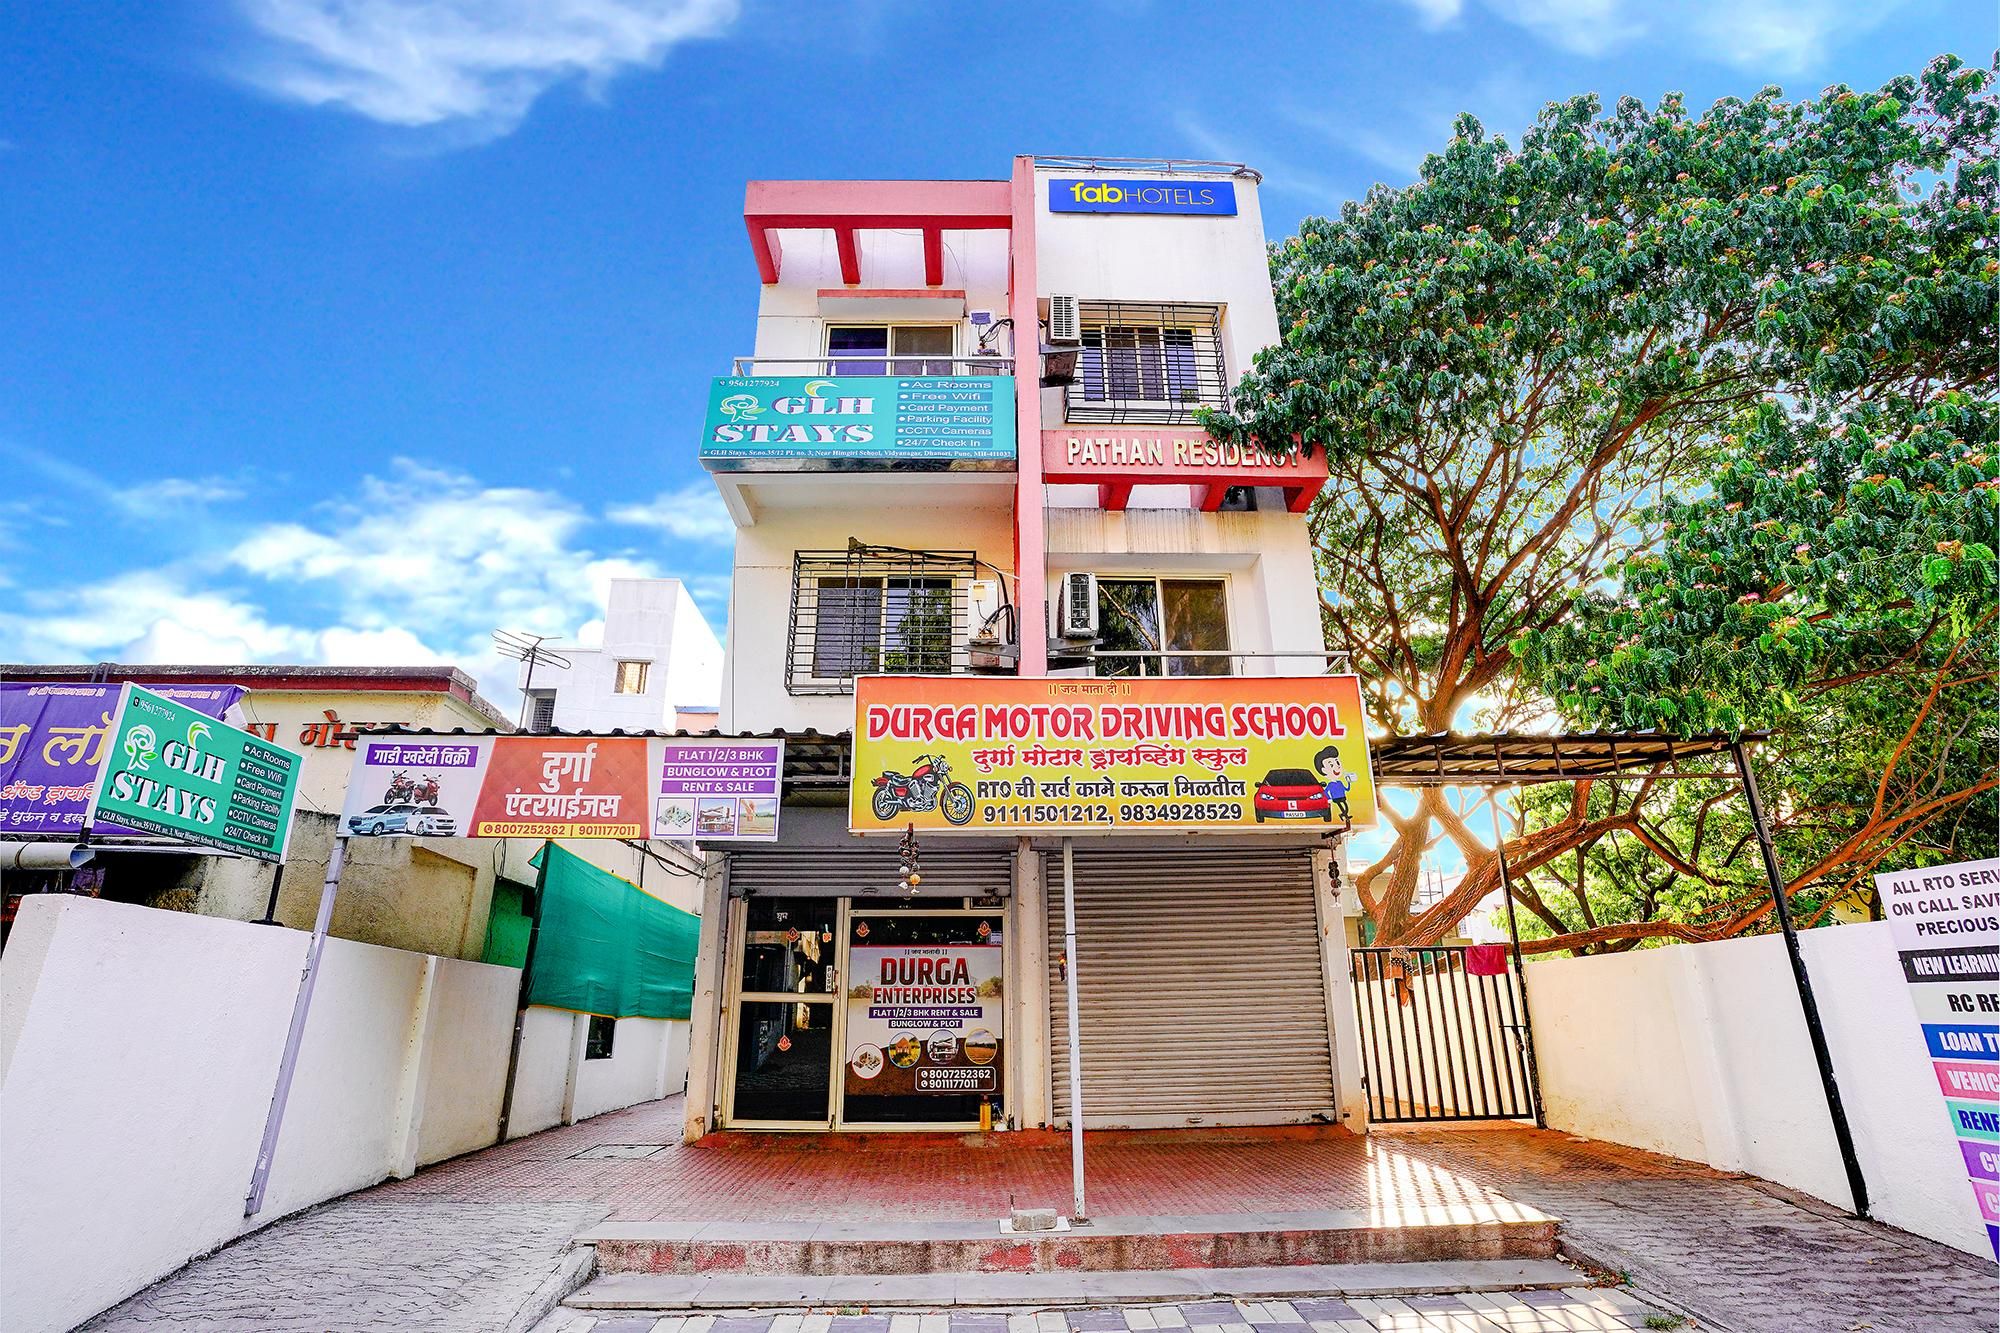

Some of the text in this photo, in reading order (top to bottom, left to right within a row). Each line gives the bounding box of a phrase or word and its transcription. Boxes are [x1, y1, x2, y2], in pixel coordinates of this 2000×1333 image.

[1070, 182, 1215, 206] fabHOTELS
[728, 380, 780, 388] 9561277924
[912, 381, 992, 389] Ac Rooms
[772, 397, 876, 415] GLH
[912, 392, 980, 400] Free Wifi
[908, 404, 988, 413] Card Payment
[907, 415, 993, 424] Parking Facility
[712, 424, 874, 443] STAYS
[905, 427, 991, 435] CCTV Cameras
[904, 439, 929, 447] 24/7
[932, 439, 967, 447] Check
[1067, 437, 1163, 465] PATHAN
[1060, 685, 1078, 694] जय
[1080, 685, 1104, 694] माता
[1106, 682, 1117, 695] दी
[869, 706, 1345, 742] DURGA MOTOR DRIVING SCHOOL
[162, 739, 227, 784] GLH
[249, 746, 291, 769] Ac Rooms
[374, 746, 471, 766] गाडी खरेदी विक्री
[678, 748, 764, 762] FLAT 1/2/3 BHK
[973, 744, 1016, 773] दुर्गा
[1022, 744, 1083, 767] मोटार
[1191, 747, 1247, 771] स्कुल
[246, 762, 283, 783] Free Wifi
[538, 742, 598, 794] दुर्गा
[667, 767, 772, 777] BUNGLOW & PLOT
[240, 777, 282, 800] Card Payment
[682, 782, 755, 792] RENT & SALE
[977, 781, 1012, 798] RTO
[1015, 776, 1036, 798] ची
[1041, 776, 1071, 798] सर्व
[1120, 781, 1169, 797] करून
[1174, 775, 1246, 797] मिळतील
[109, 770, 218, 825] STAYS
[237, 793, 280, 817] Parking Facility
[232, 809, 277, 831] CCTV Cameras
[983, 803, 1242, 824] 9111501212, 9834928529
[228, 826, 269, 845] 24/7 Check In
[494, 824, 565, 835] 8007252362
[579, 825, 636, 836] 9011177011
[1893, 880, 1920, 895] ALL
[1922, 875, 1955, 891] RTO
[1892, 902, 1915, 916] ON
[1918, 898, 1958, 914] CALL
[1916, 916, 1999, 936] PRECIOUS
[880, 957, 970, 986] DURGA
[1912, 956, 1946, 976] NEW
[873, 987, 976, 1004] ENTERPRISES
[1946, 993, 1975, 1013] RC
[893, 1008, 912, 1017] 1/2/3
[1939, 1031, 1984, 1052] LOAN
[929, 1069, 991, 1079] 8007252362
[929, 1079, 978, 1088] 9011177011
